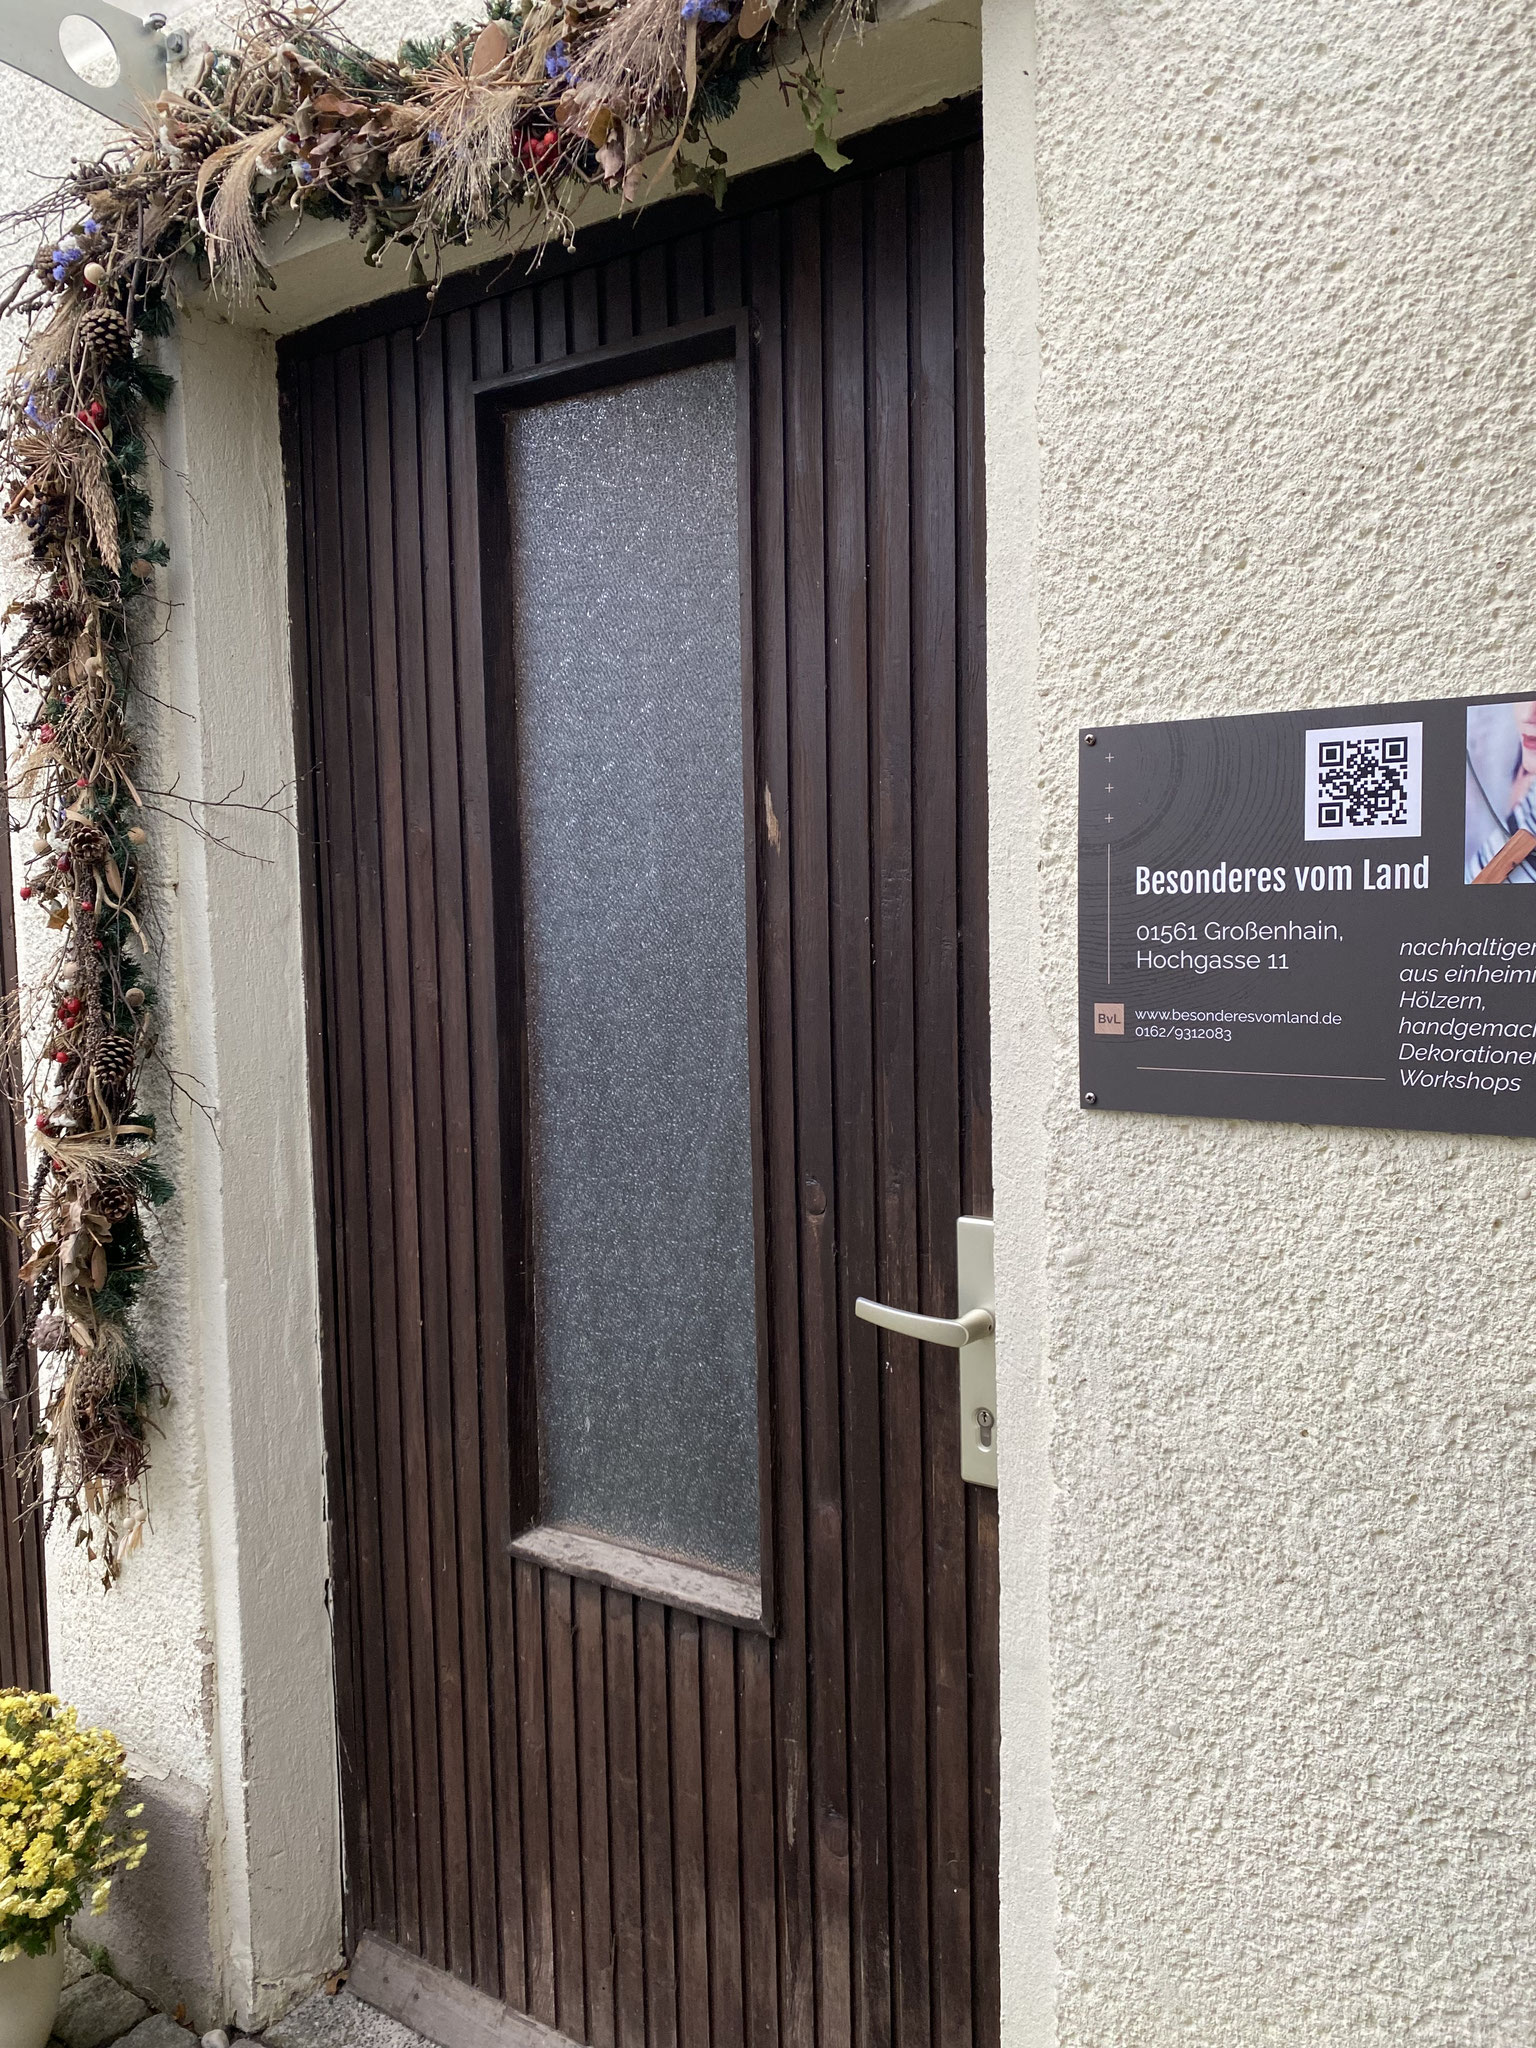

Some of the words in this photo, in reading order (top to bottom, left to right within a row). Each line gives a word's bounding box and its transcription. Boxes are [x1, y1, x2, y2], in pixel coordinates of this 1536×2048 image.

[1135, 861, 1287, 895] Besonderes
[1294, 864, 1352, 891] vom
[1363, 855, 1430, 890] Land
[1136, 923, 1199, 943] 01561
[1204, 920, 1344, 942] Großenhain,
[1136, 950, 1261, 974] Hochgasse
[1267, 954, 1289, 970] 11
[1399, 968, 1439, 983] aus
[1399, 990, 1486, 1012] Hölzern,
[1097, 1012, 1122, 1025] BvL
[1134, 1008, 1343, 1026] www.besonderesvomland.de
[1135, 1026, 1233, 1042] 0162/9312083
[1400, 1068, 1522, 1096] Workshops
